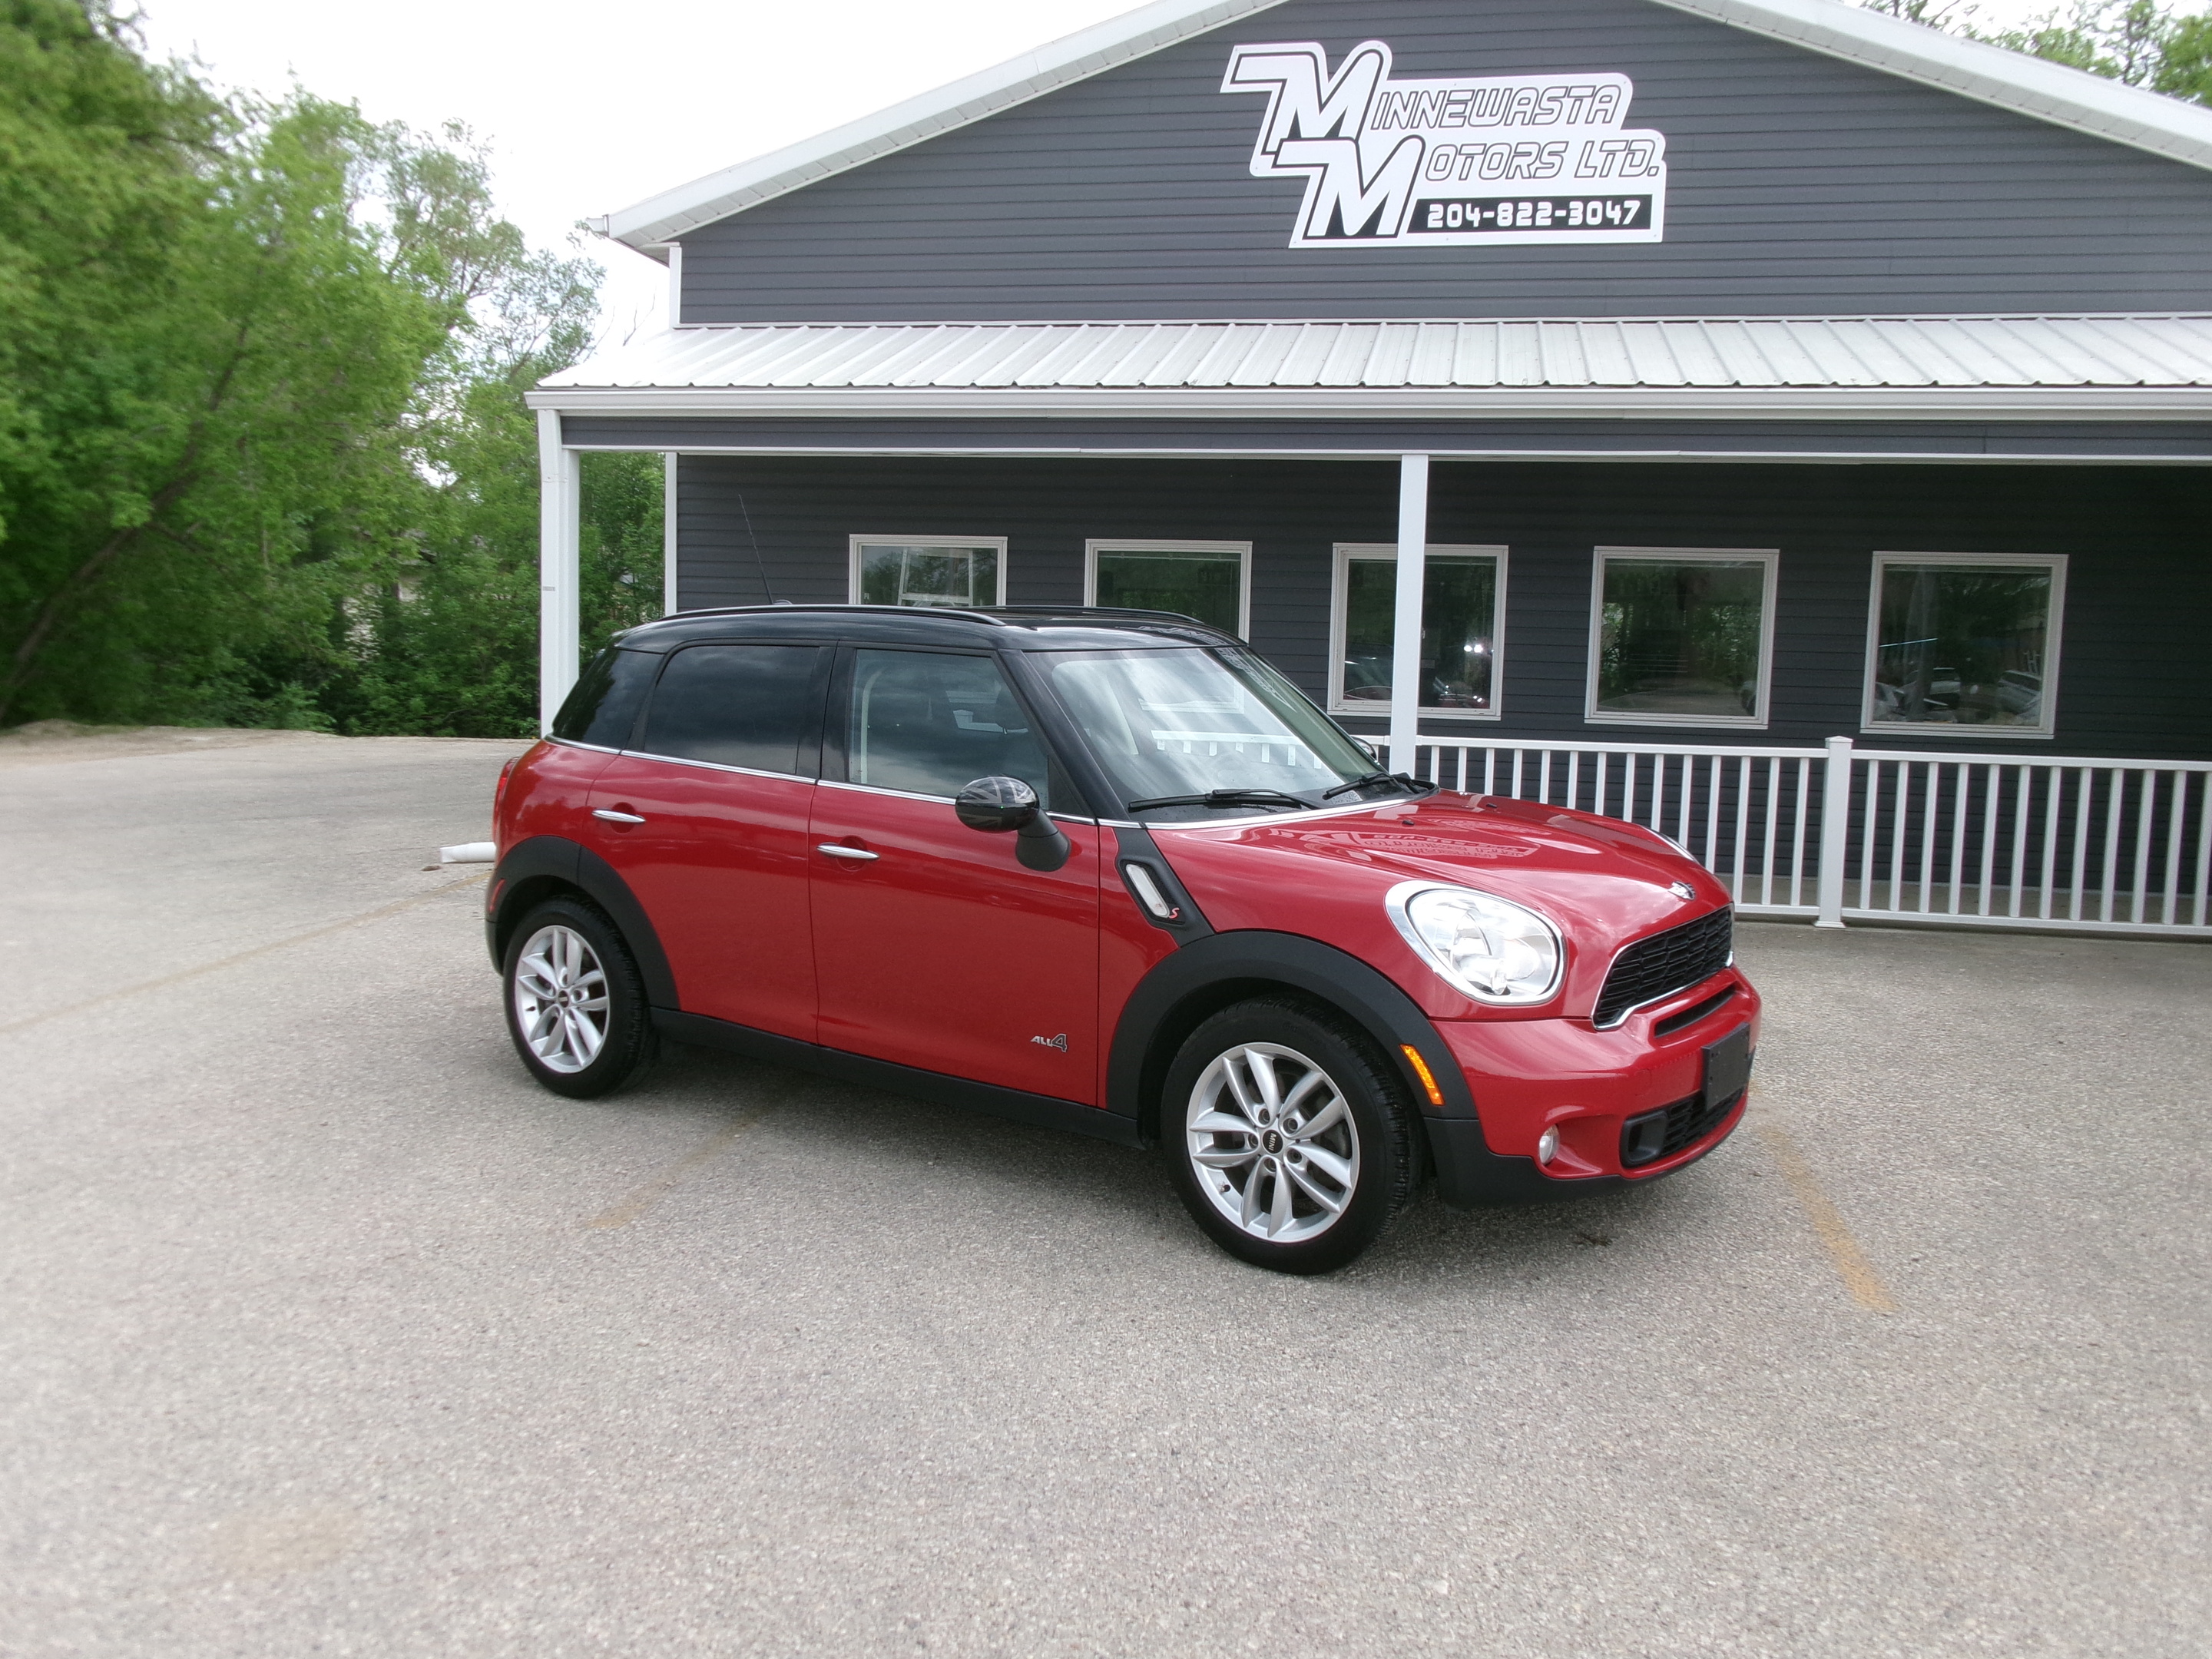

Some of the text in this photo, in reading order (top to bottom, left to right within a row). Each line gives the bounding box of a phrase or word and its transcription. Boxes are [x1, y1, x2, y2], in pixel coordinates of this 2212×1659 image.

[1229, 49, 1622, 156] MINNEWASTA
[1271, 134, 1660, 240] MOTORS LTD.
[1426, 200, 1641, 229] 204-822-3047
[1030, 1033, 1068, 1053] ALL4
